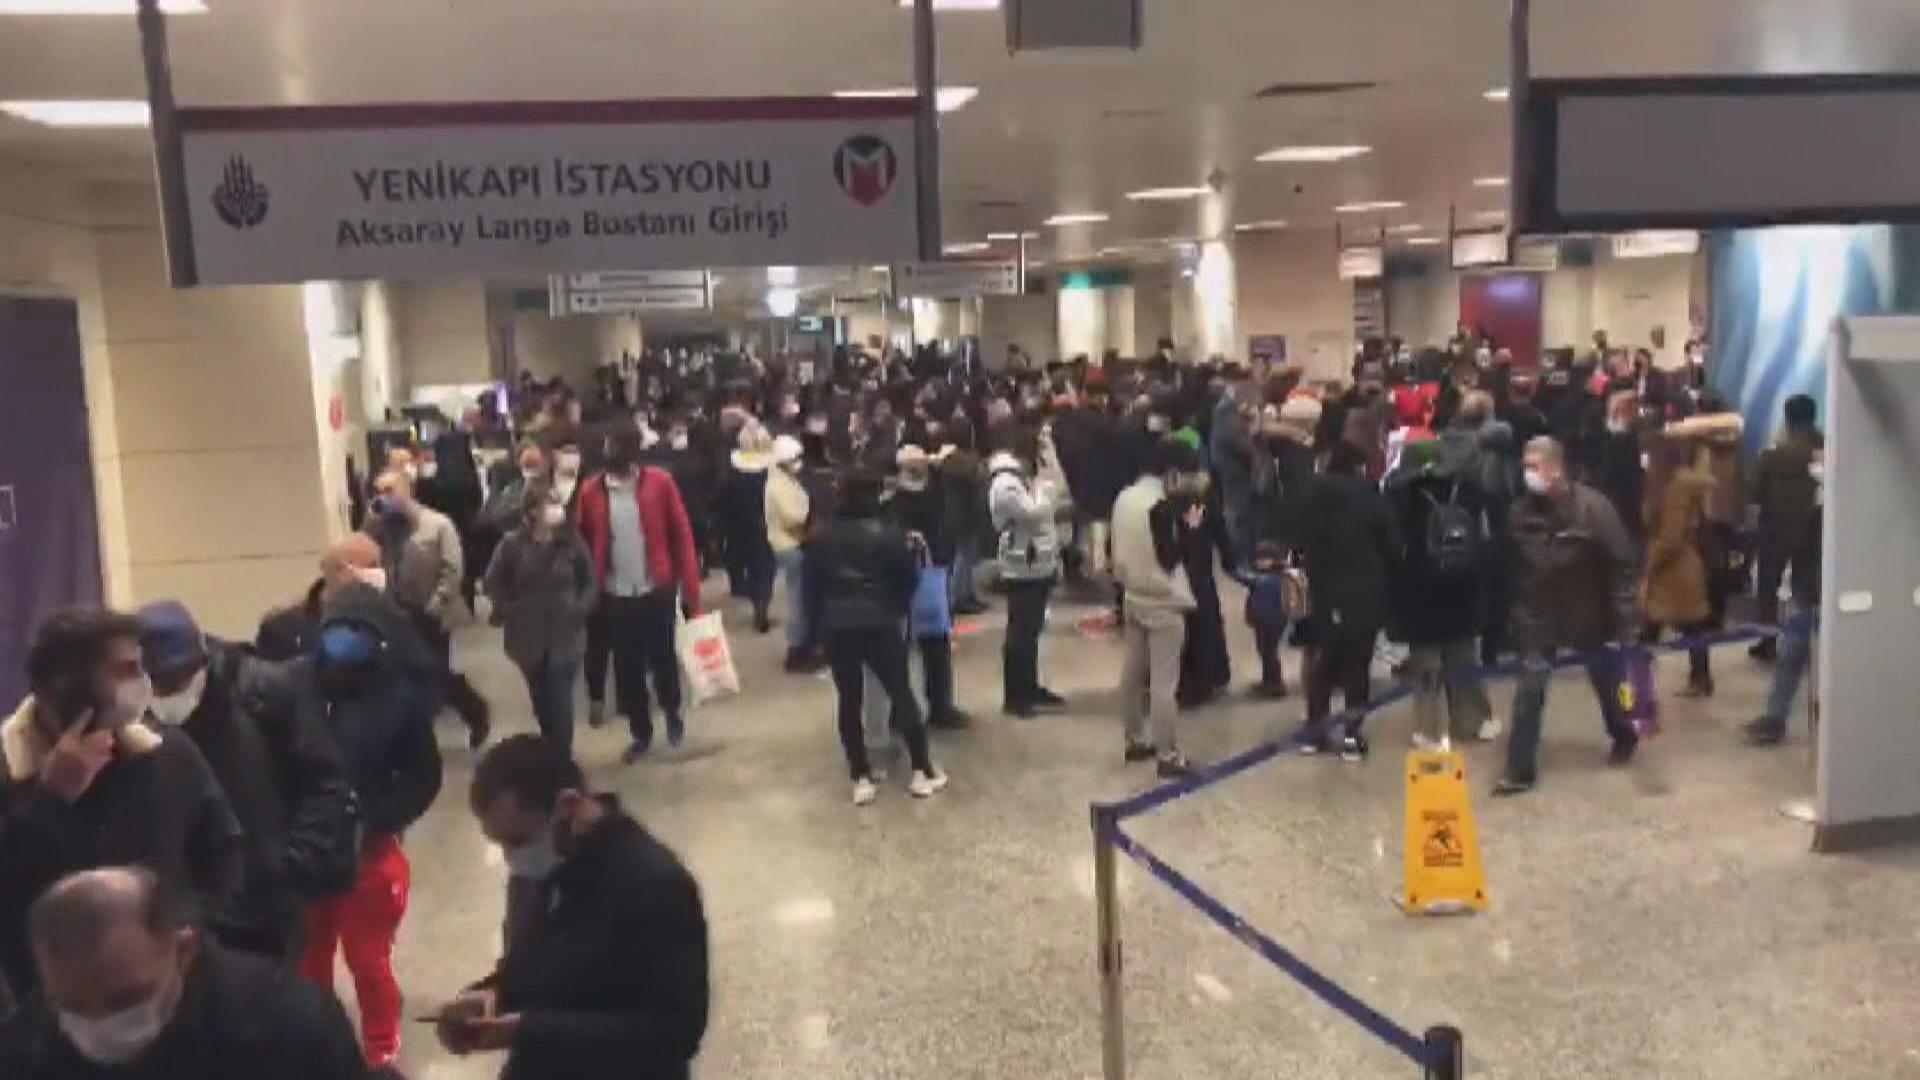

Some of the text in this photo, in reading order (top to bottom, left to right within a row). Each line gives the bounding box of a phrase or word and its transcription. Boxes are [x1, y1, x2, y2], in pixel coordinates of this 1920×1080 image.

[353, 157, 770, 201] YENİKAPI İSTASYONU
[336, 217, 464, 247] Aksaray
[583, 209, 695, 237] Bostanı
[709, 201, 788, 239] Girişi
